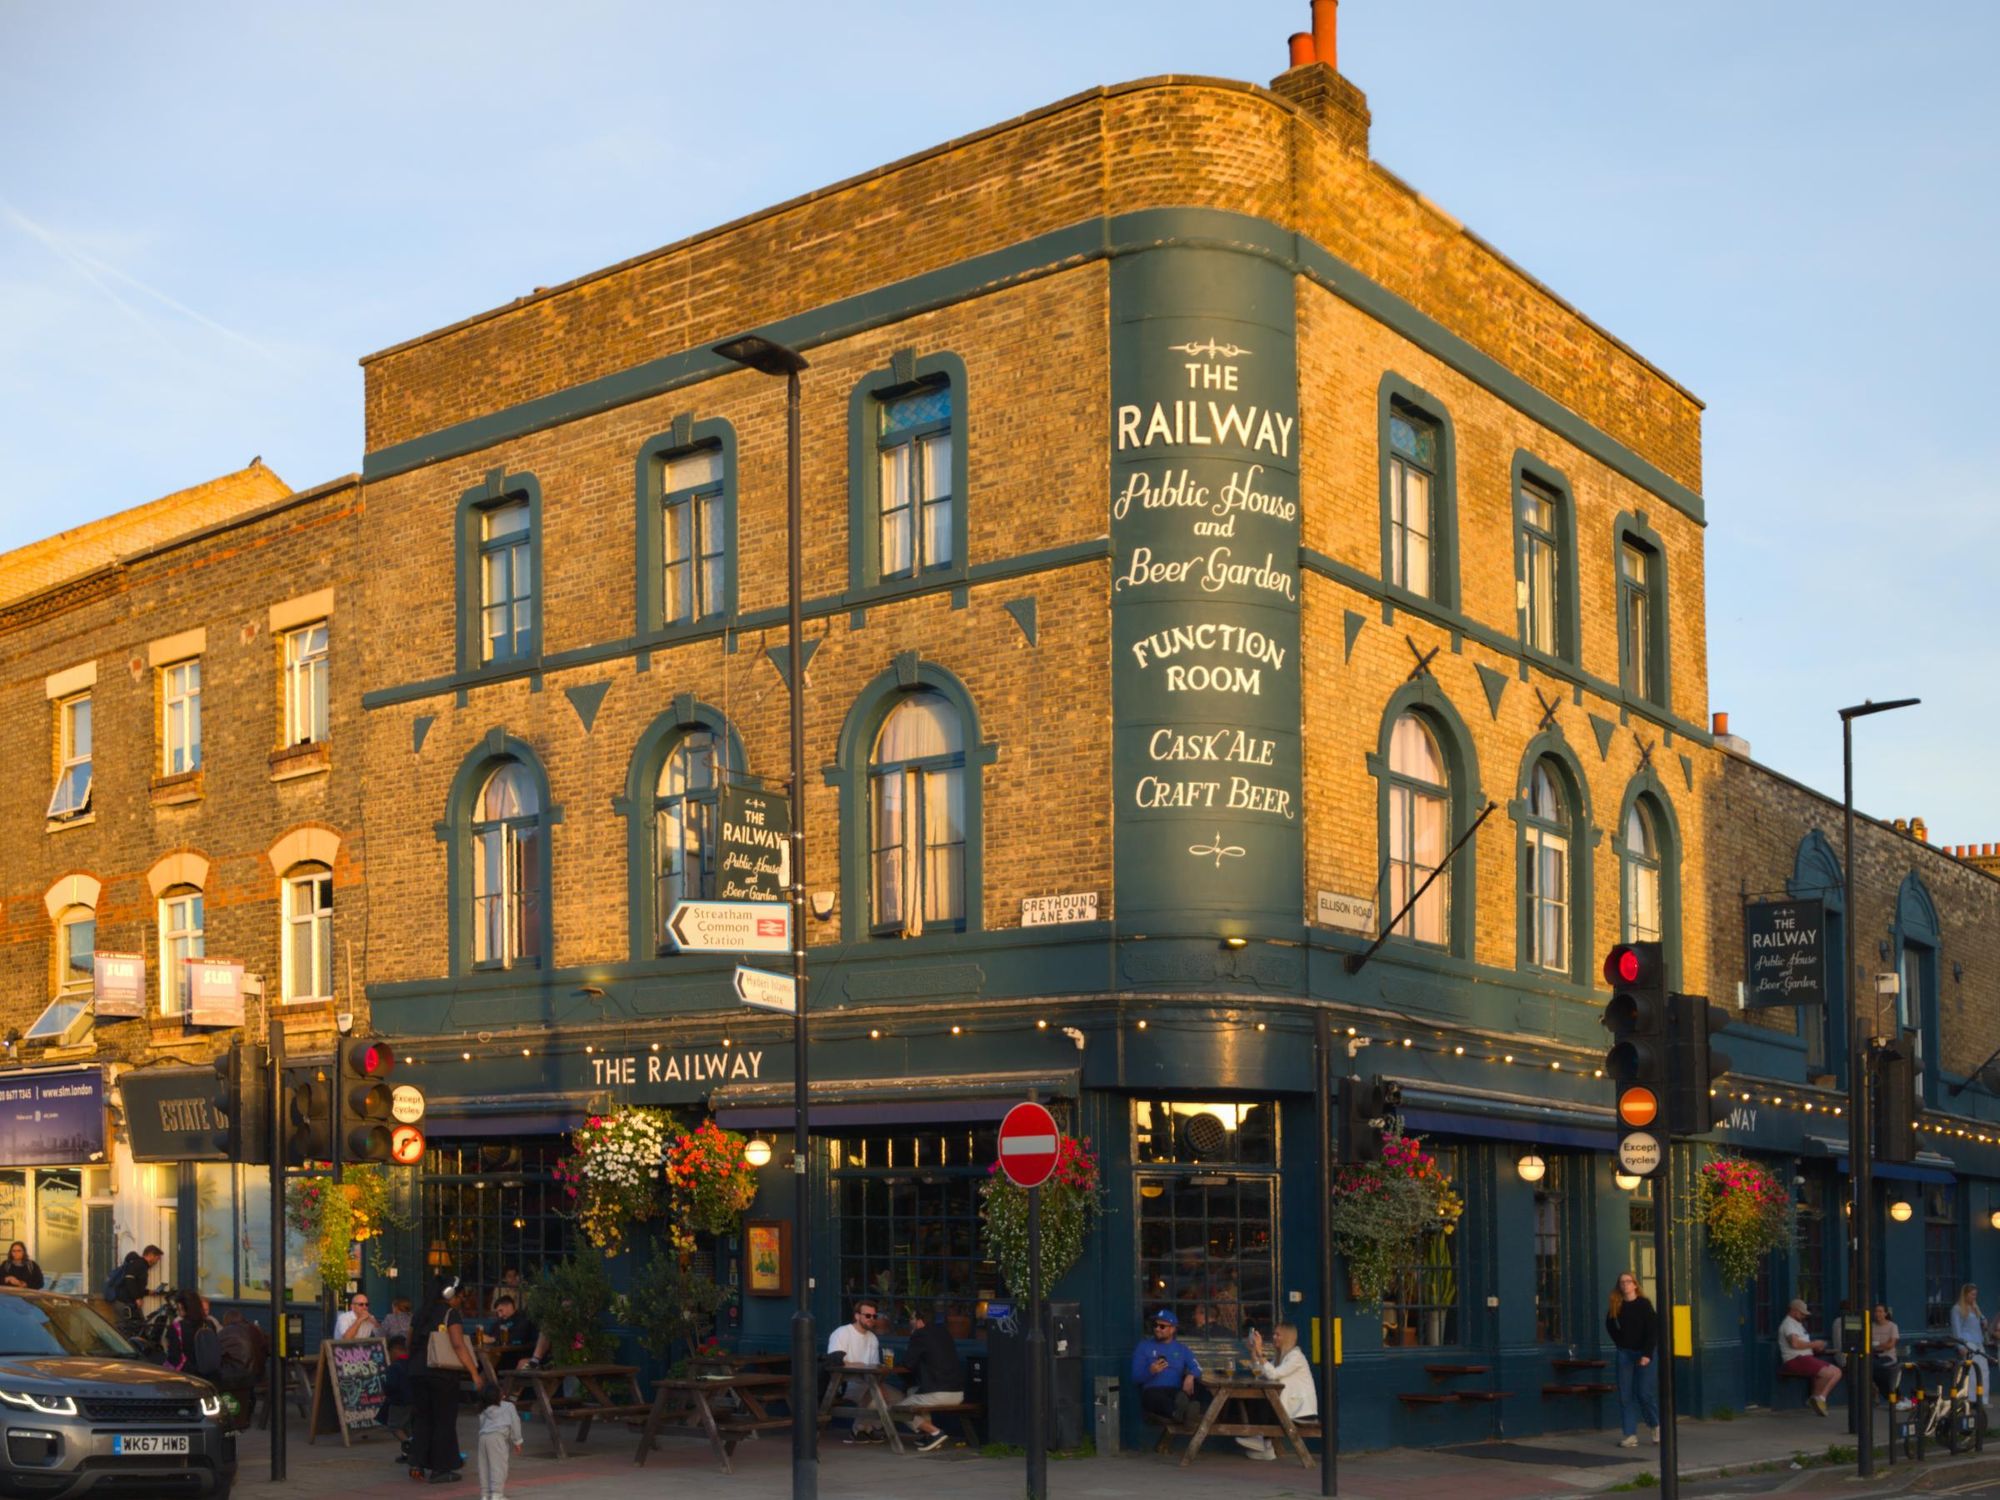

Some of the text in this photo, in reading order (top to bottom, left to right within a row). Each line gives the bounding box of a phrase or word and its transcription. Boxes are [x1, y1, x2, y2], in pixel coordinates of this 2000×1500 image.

[1185, 363, 1238, 391] THE
[1117, 400, 1293, 458] RAILWAY
[1114, 464, 1296, 522] Public House
[1193, 514, 1235, 537] and
[1115, 546, 1295, 601] Beer Garden
[1132, 624, 1286, 671] FUNCTION
[1166, 665, 1260, 695] ROOM
[1150, 729, 1276, 766] CASK ALE
[1135, 776, 1294, 820] CRAFT BEER
[744, 810, 765, 826] THE
[723, 822, 783, 850] RAILWAY
[723, 851, 753, 871] Public
[745, 873, 758, 884] and
[722, 880, 778, 900] Beer Garden
[1023, 895, 1097, 912] GREYHOUND
[1320, 897, 1373, 919] ELLISON ROAD
[694, 908, 753, 920] Streatham
[697, 921, 750, 933] Common
[1774, 918, 1796, 930] THE
[703, 933, 745, 946] Station
[1752, 929, 1817, 948] RAILWAY
[1754, 950, 1817, 971] Public House
[1779, 967, 1793, 977] and
[1756, 975, 1818, 992] Beer Garden
[592, 1051, 763, 1085] THE RAILWAY
[42, 1083, 94, 1098] www.slm.london
[393, 1093, 422, 1104] Except
[158, 1098, 211, 1132] ESTATE
[394, 1106, 421, 1115] cycles
[1623, 1143, 1657, 1153] Except
[1625, 1155, 1656, 1165] cycles
[123, 1437, 158, 1451] WK67
